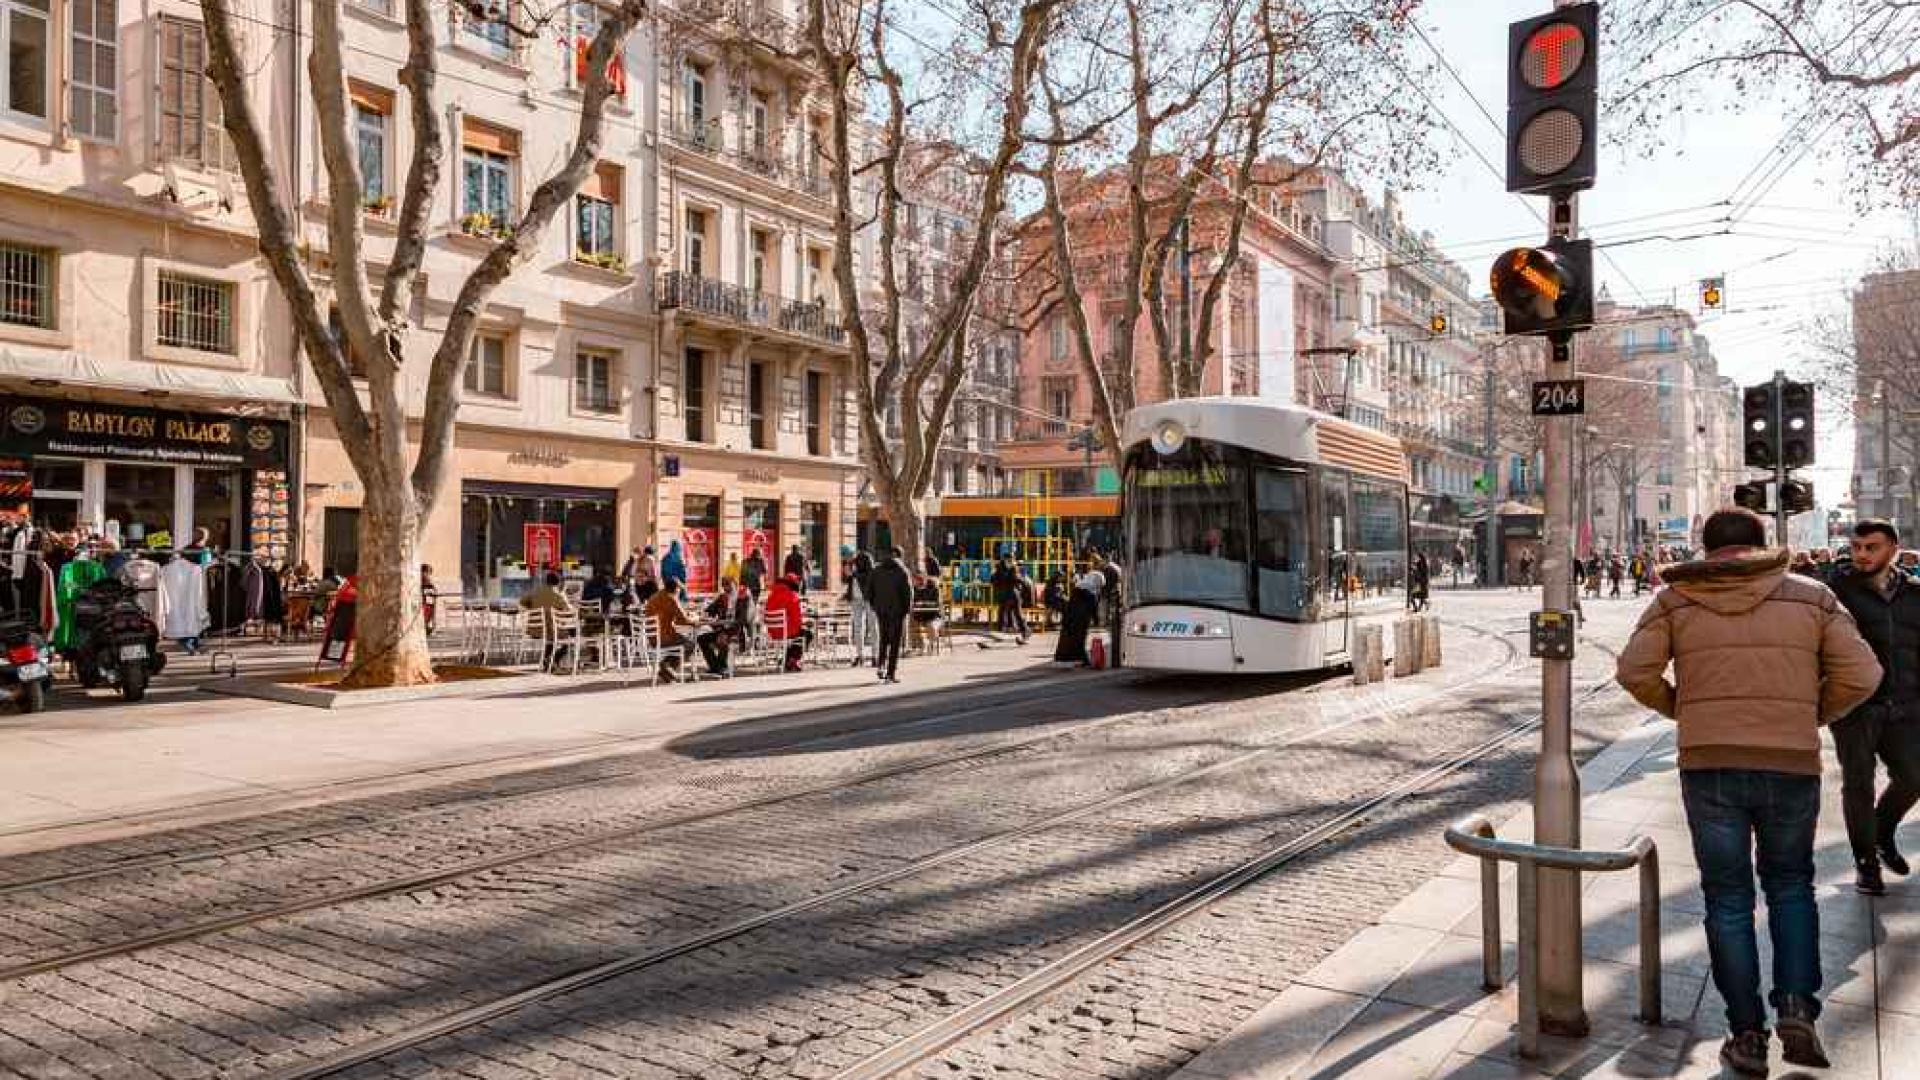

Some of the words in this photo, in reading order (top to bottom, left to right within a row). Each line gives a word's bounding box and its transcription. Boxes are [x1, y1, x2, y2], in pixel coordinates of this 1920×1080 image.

[1538, 385, 1579, 410] 204
[68, 410, 154, 437] BABYLON
[166, 420, 231, 443] PALACE
[1152, 621, 1188, 633] RTM
